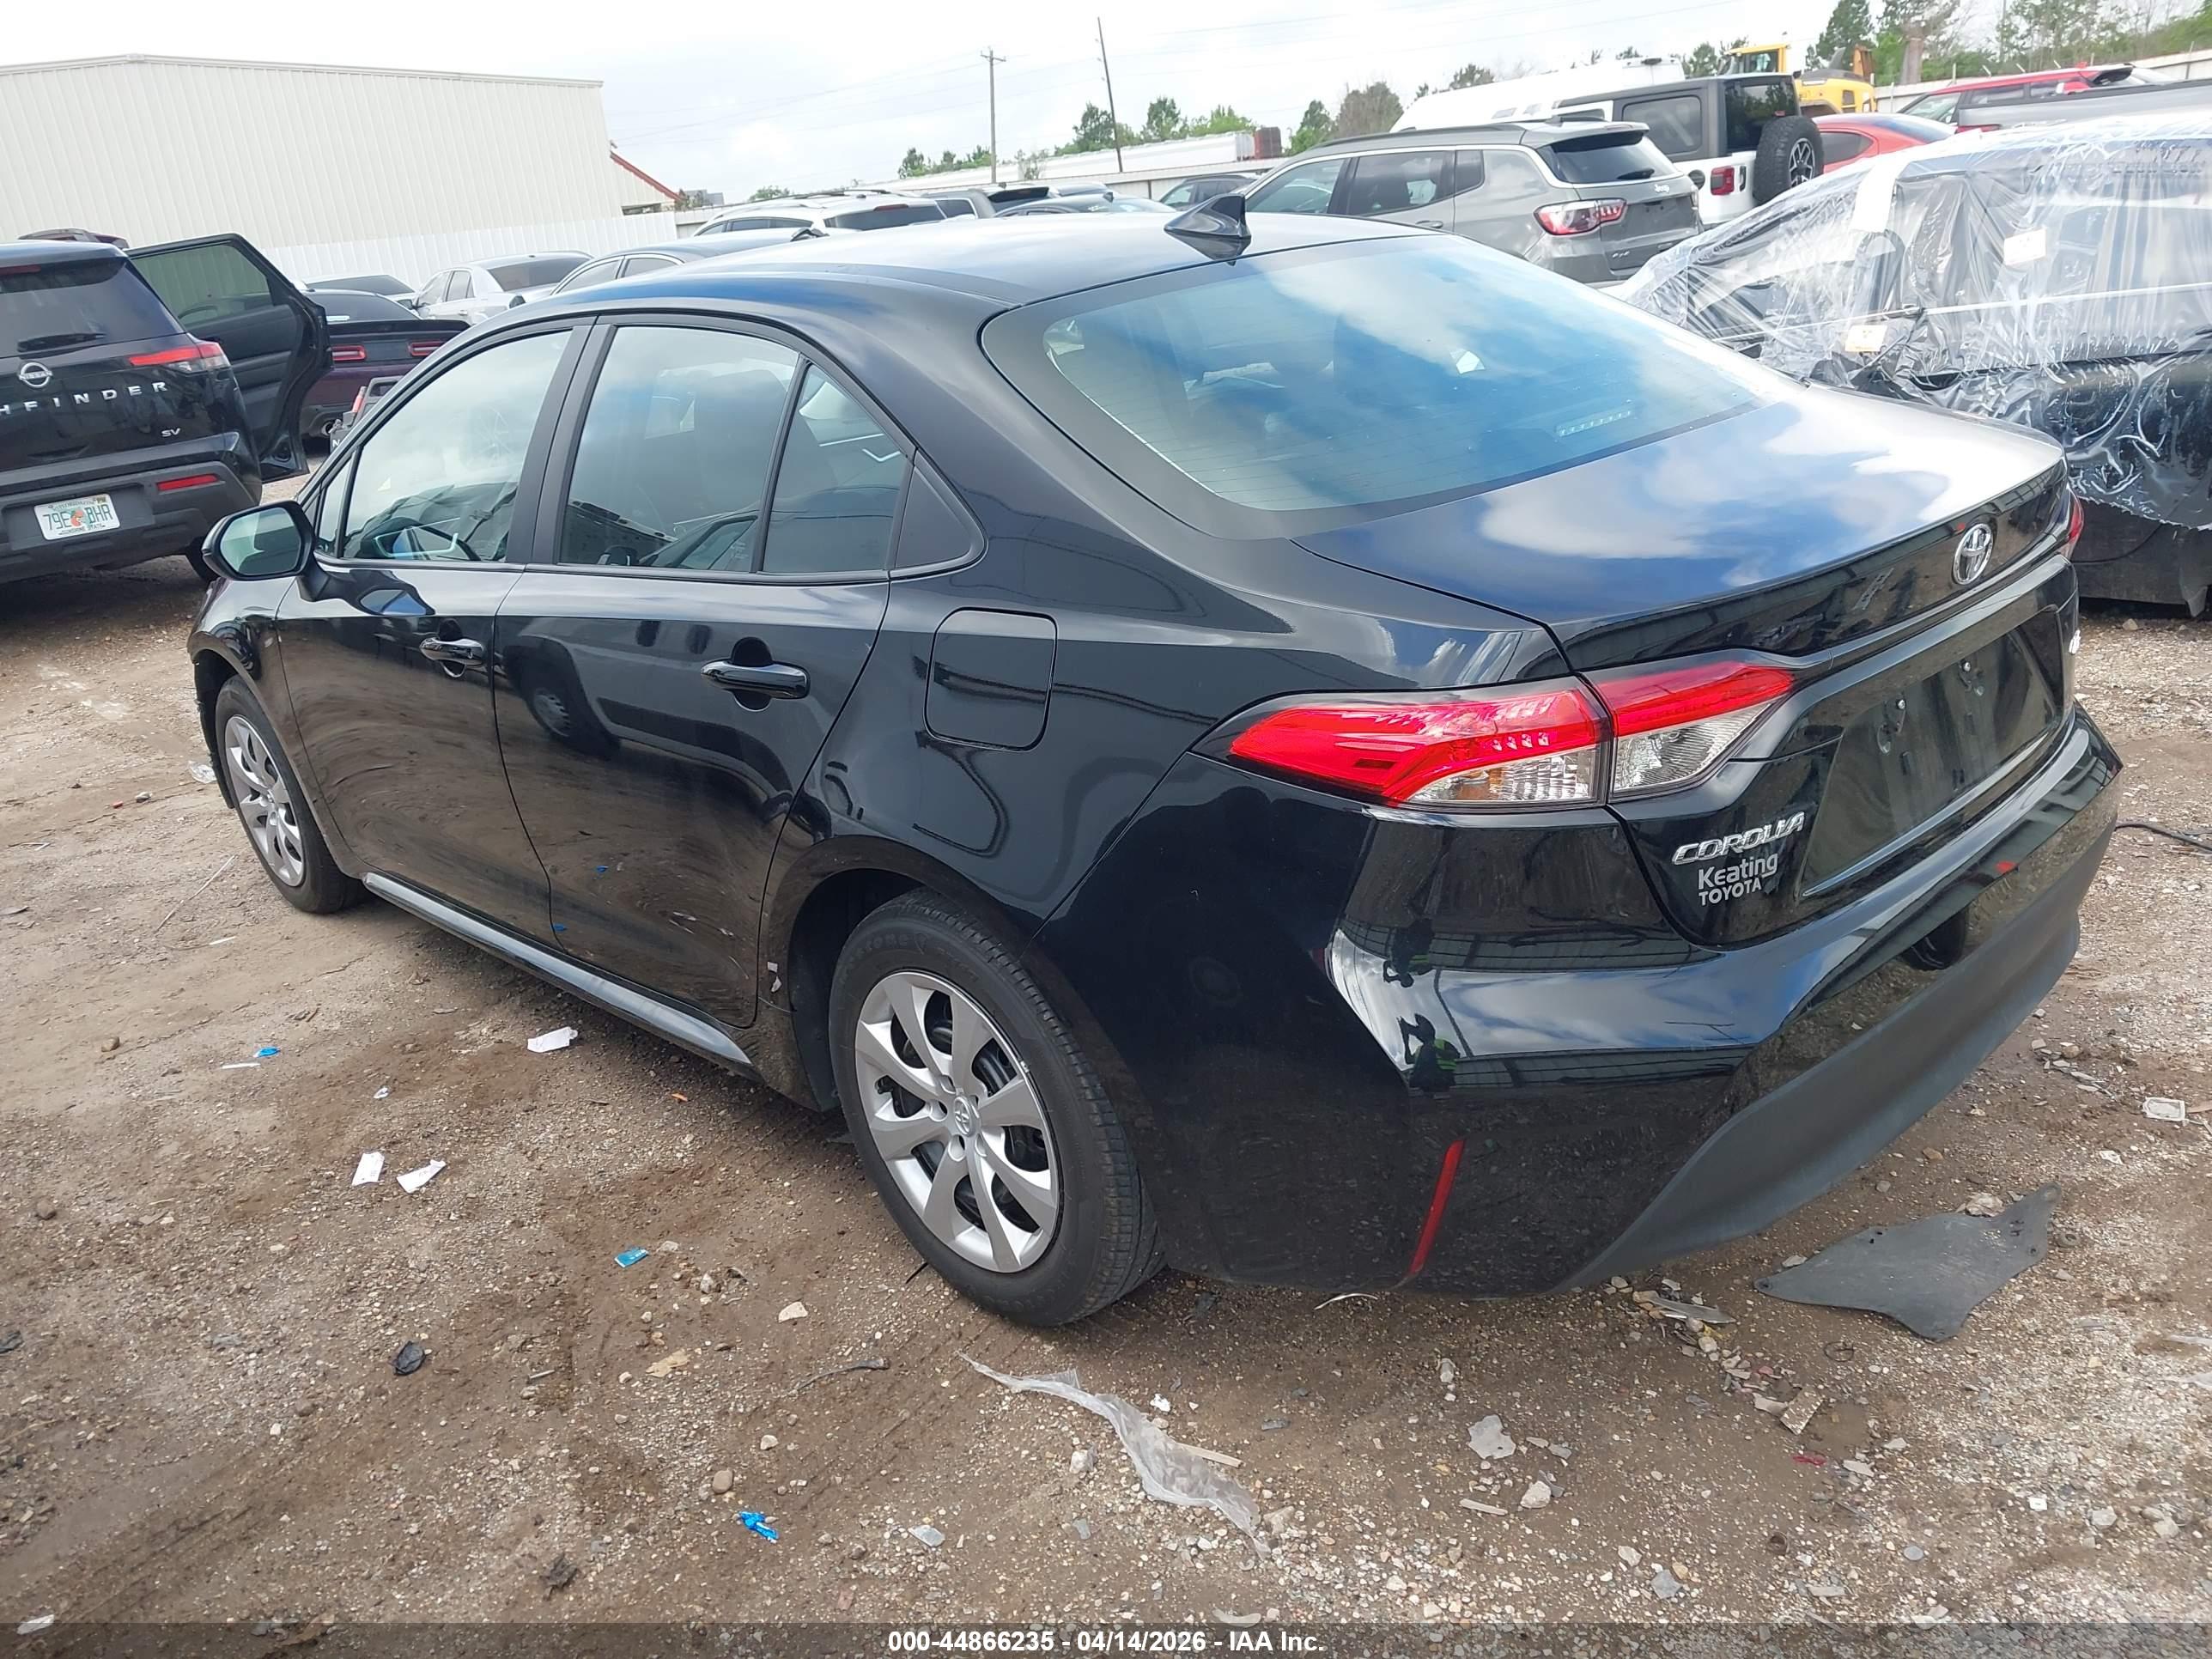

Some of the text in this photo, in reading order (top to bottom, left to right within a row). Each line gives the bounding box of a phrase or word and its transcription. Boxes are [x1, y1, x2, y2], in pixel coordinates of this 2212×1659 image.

[161, 428, 181, 437] SV
[43, 511, 71, 530] 79E
[84, 504, 113, 524] BHR
[1672, 811, 1804, 865] COROLLA
[1698, 853, 1778, 890] Keating
[1698, 878, 1762, 906] TOYOTA
